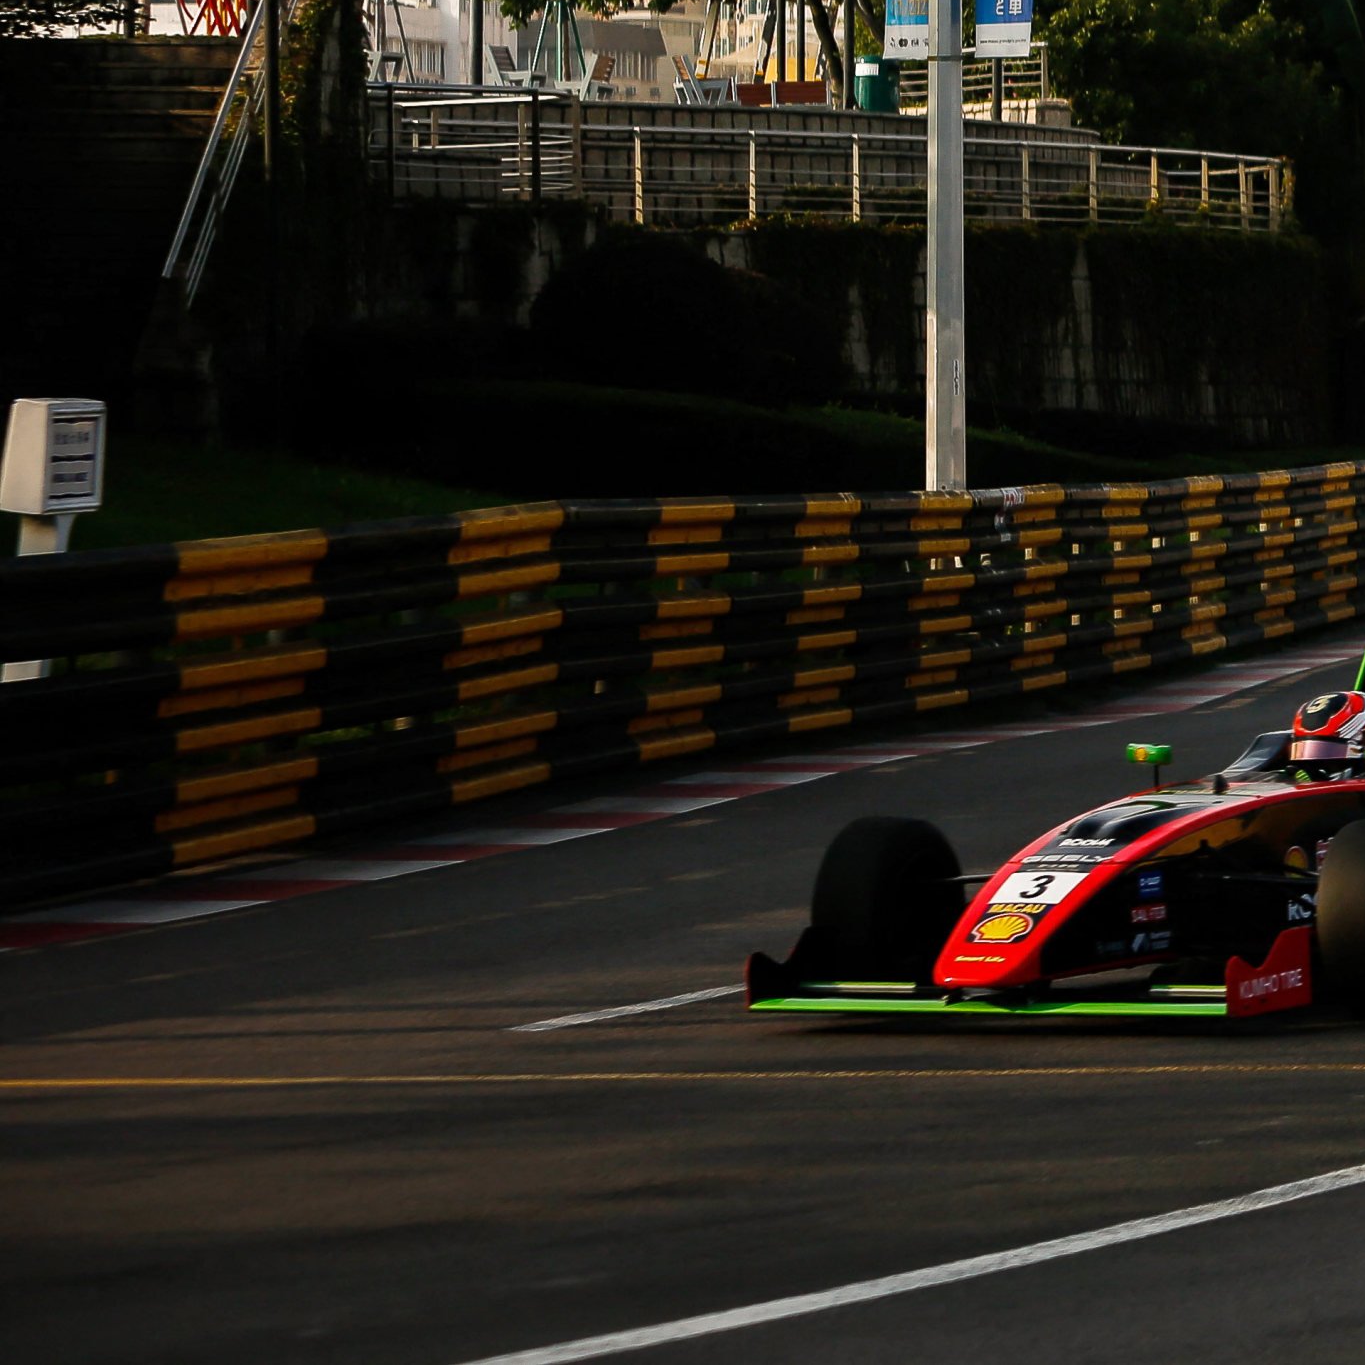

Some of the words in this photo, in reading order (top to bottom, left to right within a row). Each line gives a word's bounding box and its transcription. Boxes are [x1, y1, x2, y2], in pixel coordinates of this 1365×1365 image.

[1020, 854, 1115, 864] GEELY
[1020, 875, 1056, 899] 3
[988, 904, 1046, 914] MACAU
[1240, 974, 1279, 999] KUMHO
[1280, 969, 1304, 988] TIRE
